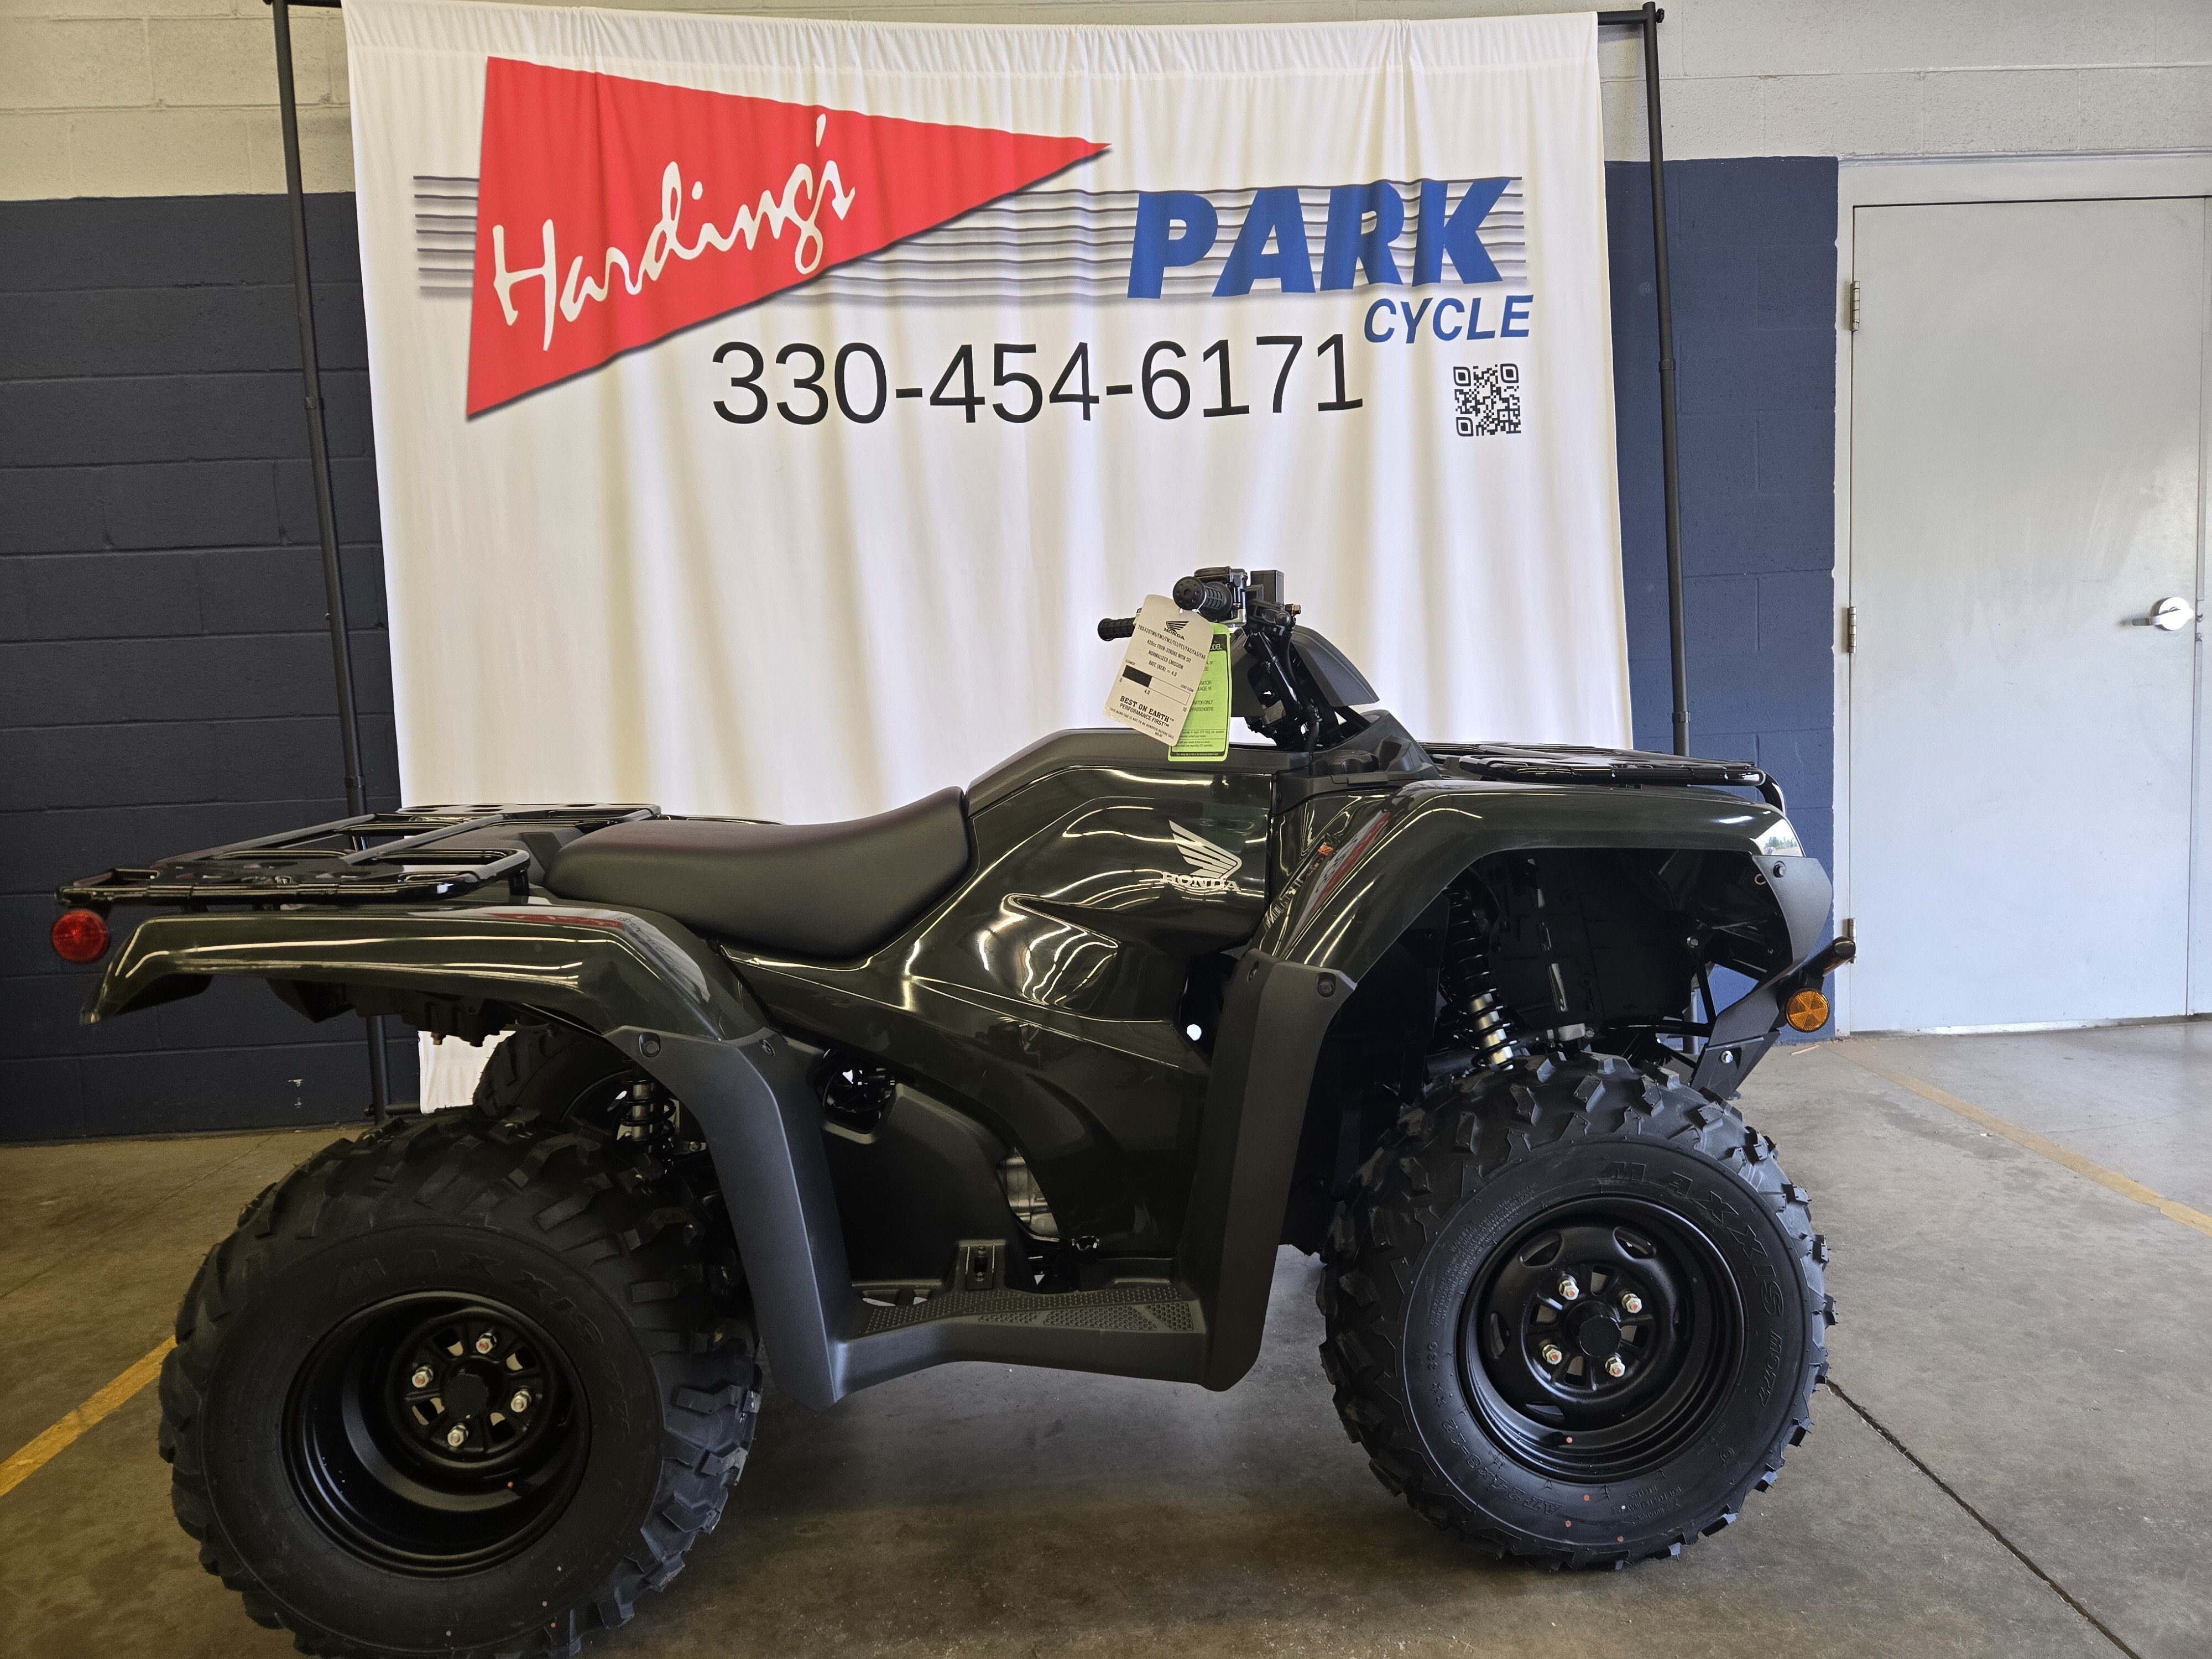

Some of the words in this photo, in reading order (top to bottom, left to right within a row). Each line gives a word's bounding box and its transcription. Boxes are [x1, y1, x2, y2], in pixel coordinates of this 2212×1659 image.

[493, 113, 855, 351] Harding's
[1127, 177, 1511, 299] PARK
[1364, 294, 1534, 343] CYCLE
[712, 333, 1363, 425] 330-454-6171
[1164, 628, 1185, 640] HONDA
[1147, 650, 1168, 662] NORMALIZED
[1167, 659, 1184, 669] EMISSION
[1156, 644, 1178, 657] FOUR-STROKE
[1119, 695, 1138, 707] BEST
[1138, 703, 1147, 712] ON
[1119, 702, 1152, 721] PERFORMANCE
[1160, 872, 1241, 892] HONDA
[1604, 1160, 1785, 1317] MAXXIS
